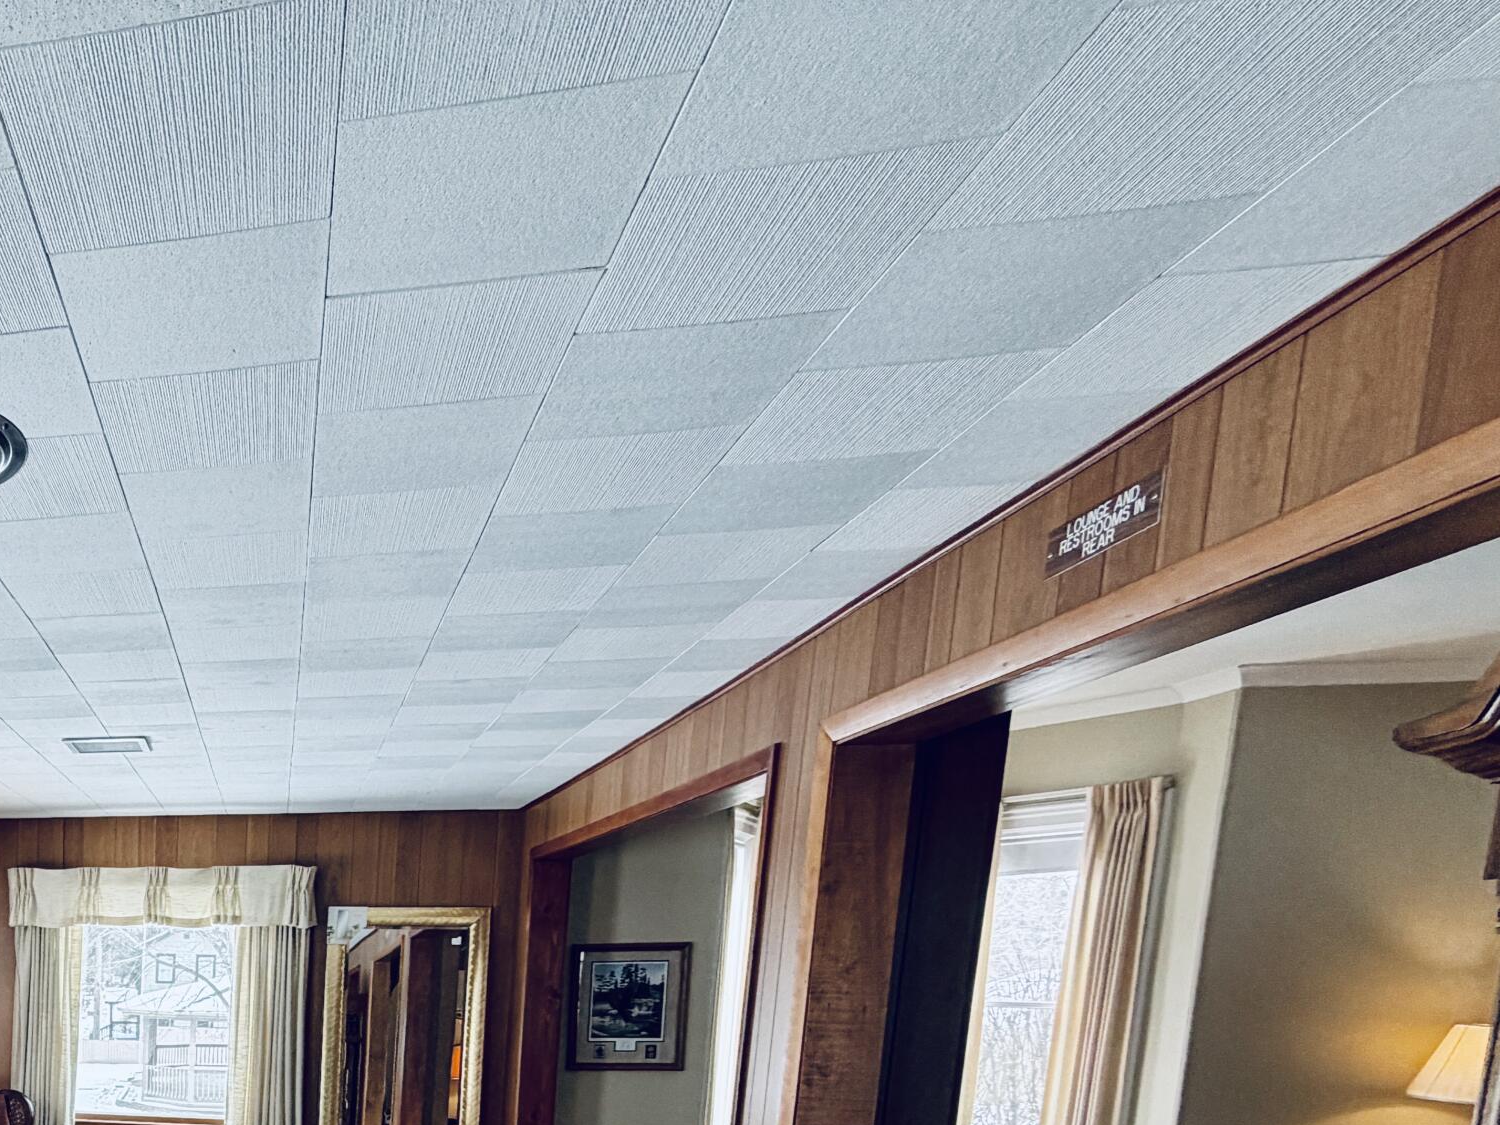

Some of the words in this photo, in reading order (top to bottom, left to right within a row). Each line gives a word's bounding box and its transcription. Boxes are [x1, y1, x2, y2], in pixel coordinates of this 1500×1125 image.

[1058, 504, 1130, 556] RESTROOMS
[1133, 495, 1146, 516] IN
[1066, 499, 1112, 537] LOUNGE
[1114, 484, 1140, 511] AND
[1081, 528, 1115, 557] REAR
